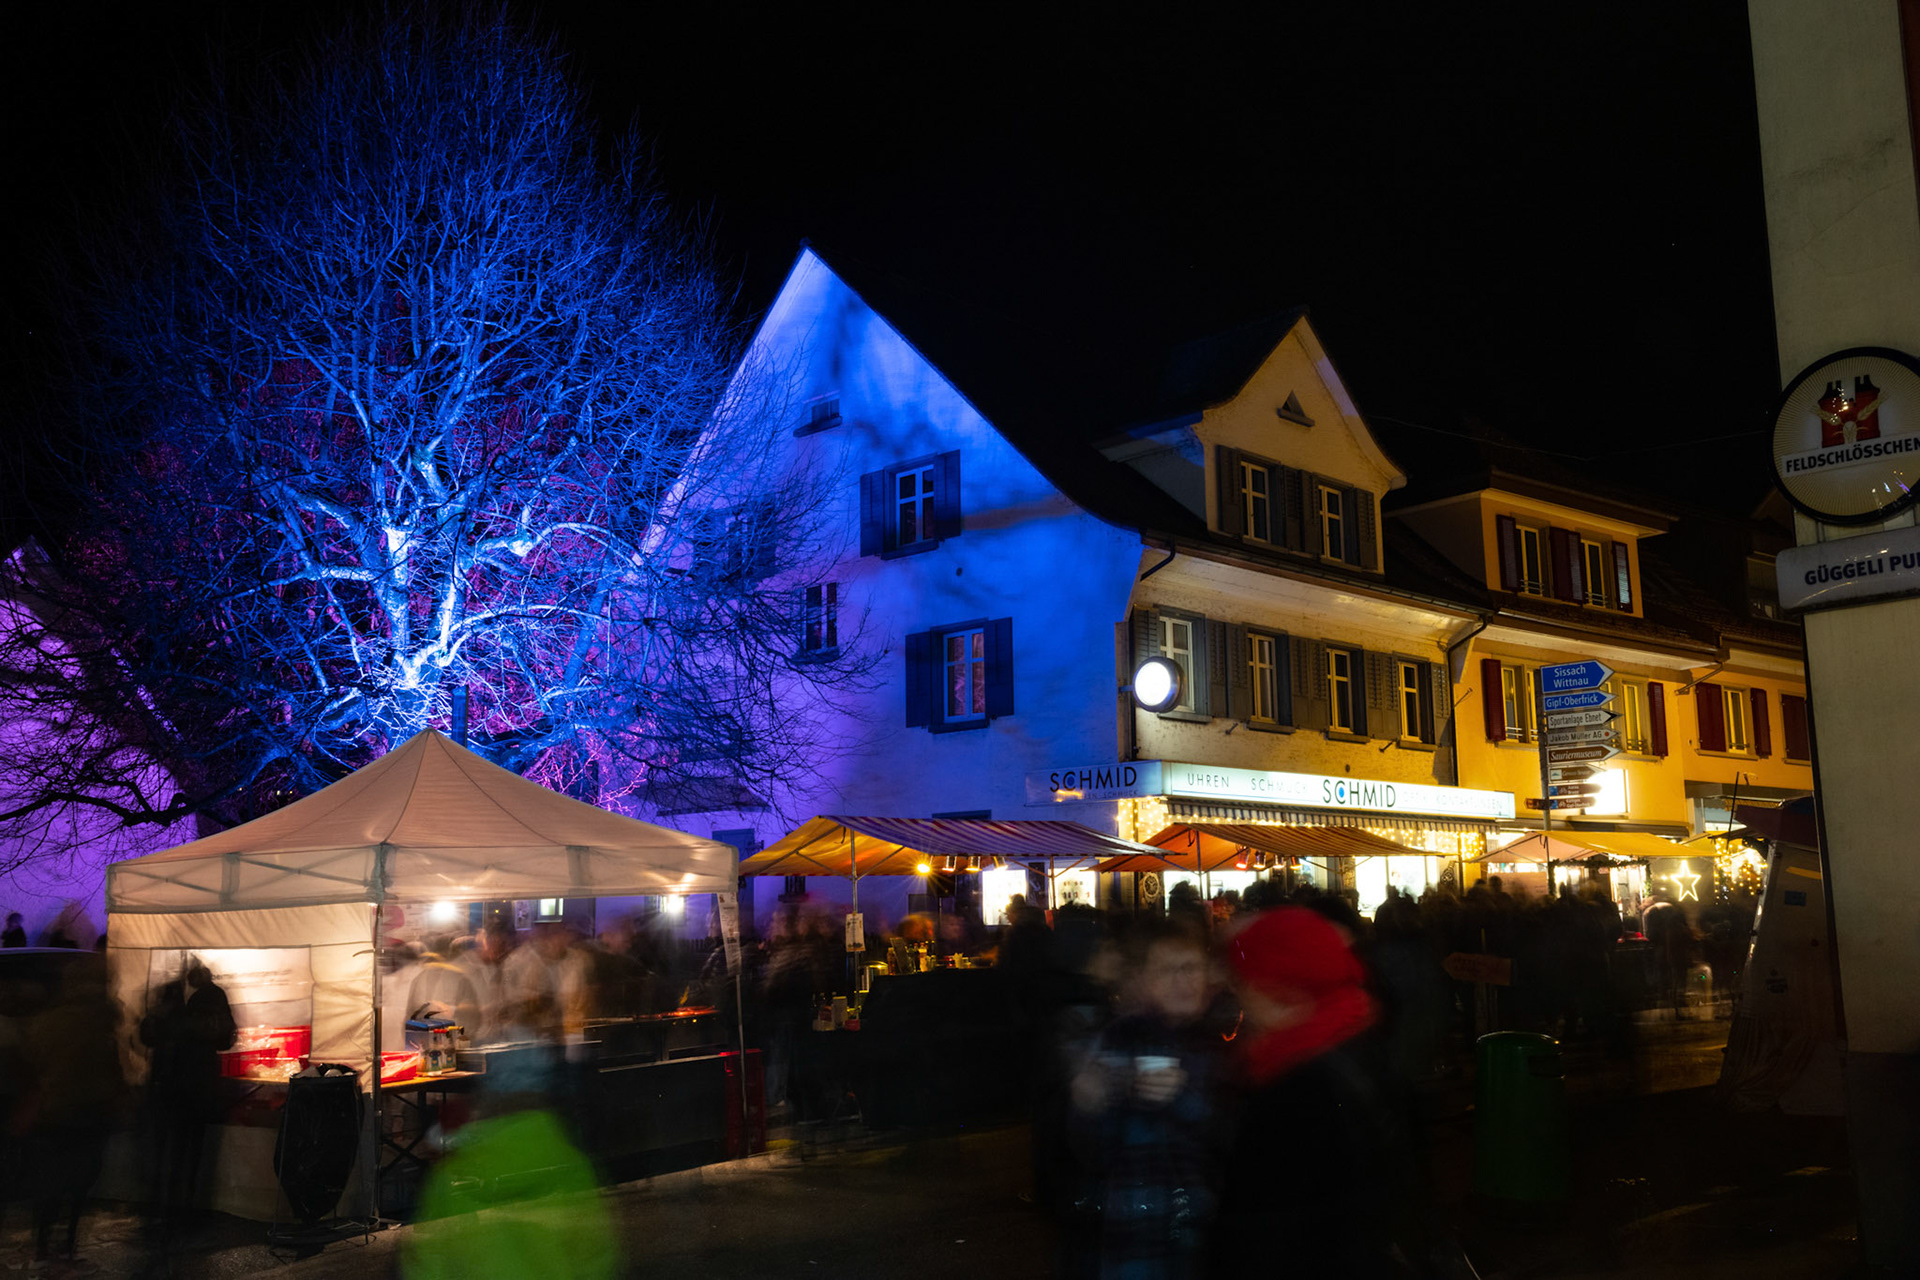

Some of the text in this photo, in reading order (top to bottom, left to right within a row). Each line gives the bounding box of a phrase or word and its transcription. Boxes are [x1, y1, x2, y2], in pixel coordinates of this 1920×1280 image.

[1786, 437, 1920, 473] FELDSCHLÖSSCHEN
[1805, 557, 1884, 586] GÜGGELI
[1554, 664, 1586, 678] Sissach
[1553, 677, 1589, 688] Wittnau
[1546, 693, 1599, 709] Gipf-Oberfrick
[1550, 712, 1602, 727] Sportanlage Ebnet
[1550, 731, 1602, 742] Jakob Müller AG
[1551, 749, 1603, 760] Sauriermuseum
[1049, 766, 1138, 793] SCHMID
[1187, 772, 1230, 788] UHREN
[1322, 778, 1397, 808] SCHMID
